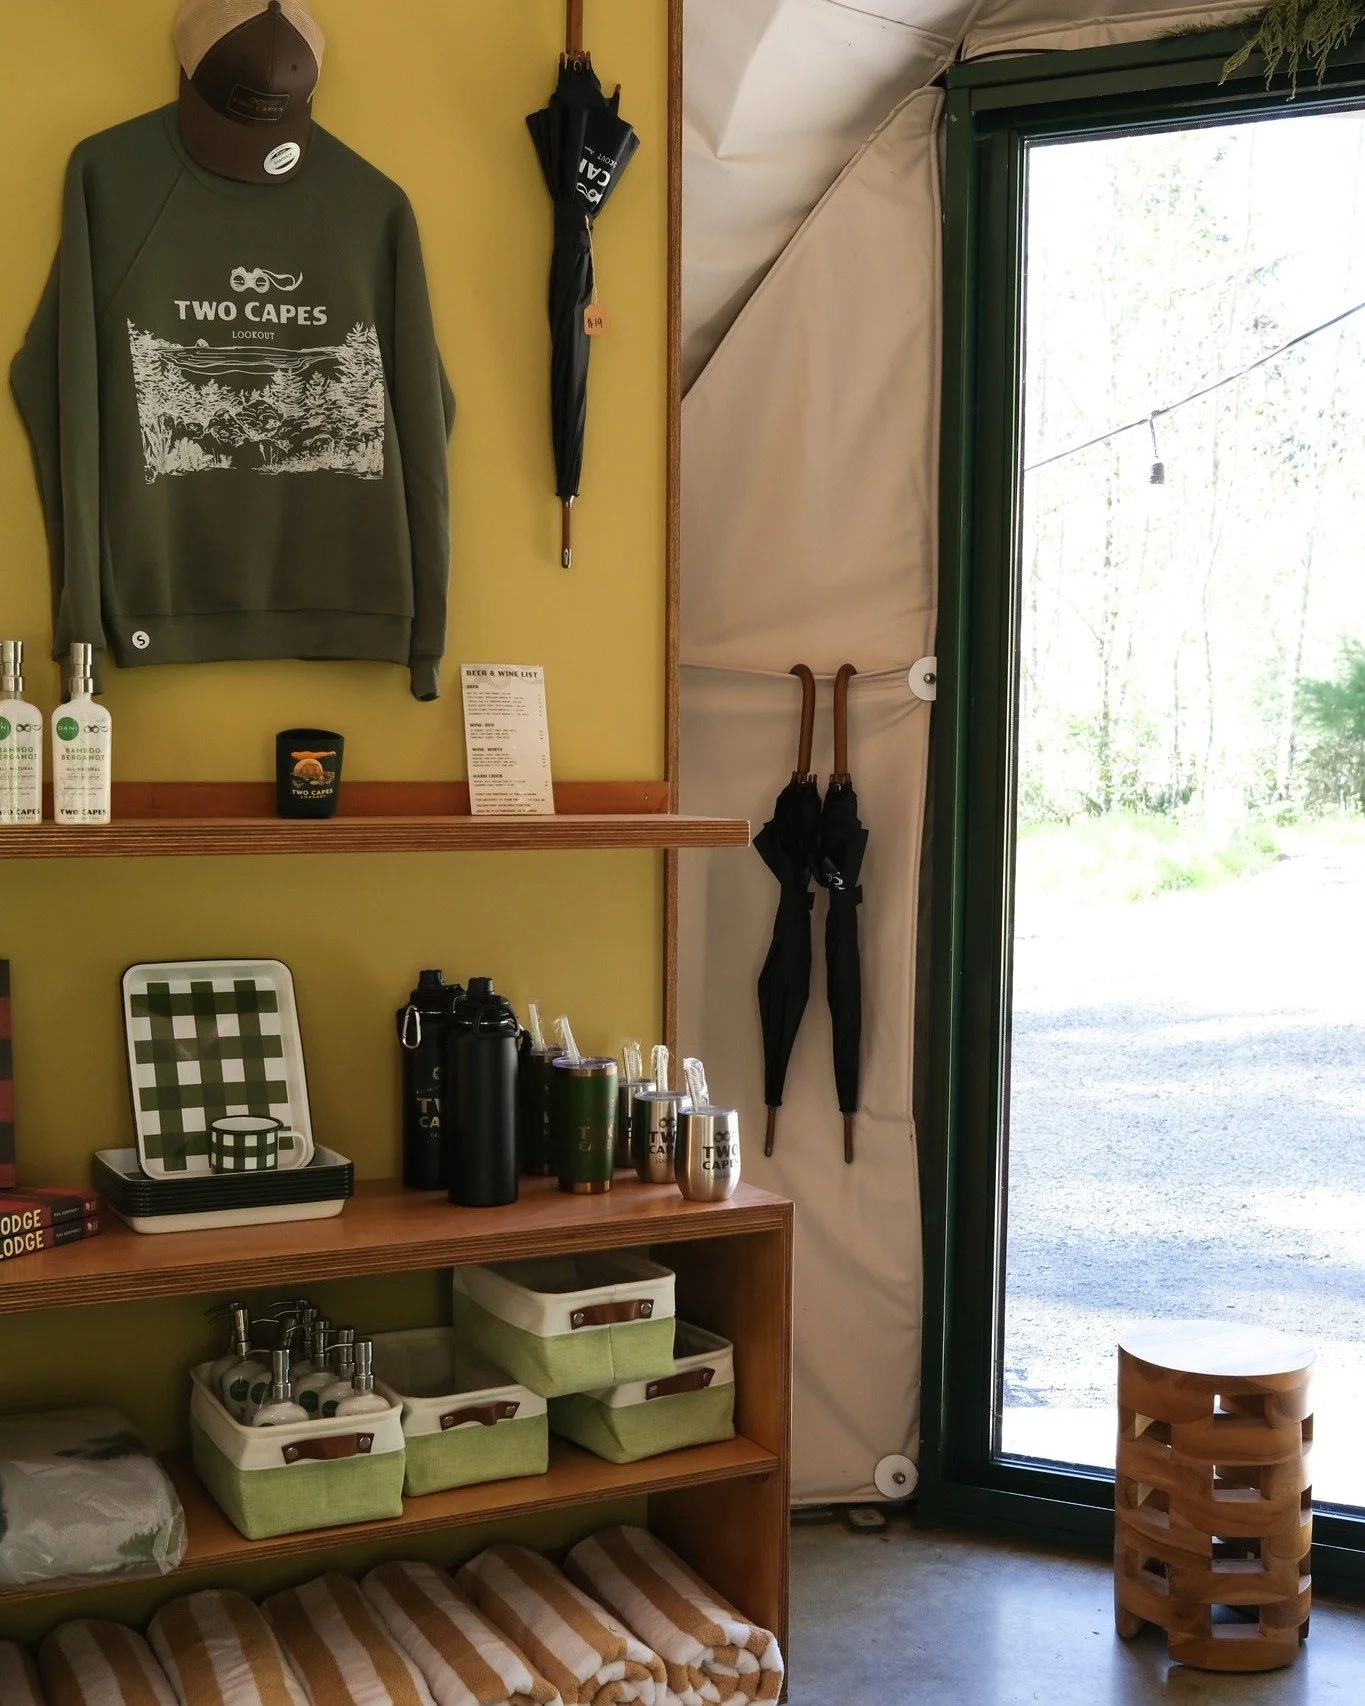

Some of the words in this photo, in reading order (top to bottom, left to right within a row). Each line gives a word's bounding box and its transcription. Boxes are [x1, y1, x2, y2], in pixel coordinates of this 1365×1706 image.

[174, 300, 237, 321] TWO
[244, 301, 328, 326] CAPES
[232, 331, 275, 340] LOOKOUT
[498, 670, 518, 678] WINE
[16, 808, 41, 816] CAPES
[60, 808, 79, 816] TWO
[82, 808, 107, 816] CAPES
[702, 1143, 738, 1158] TWO
[0, 1229, 44, 1259] ODGE
